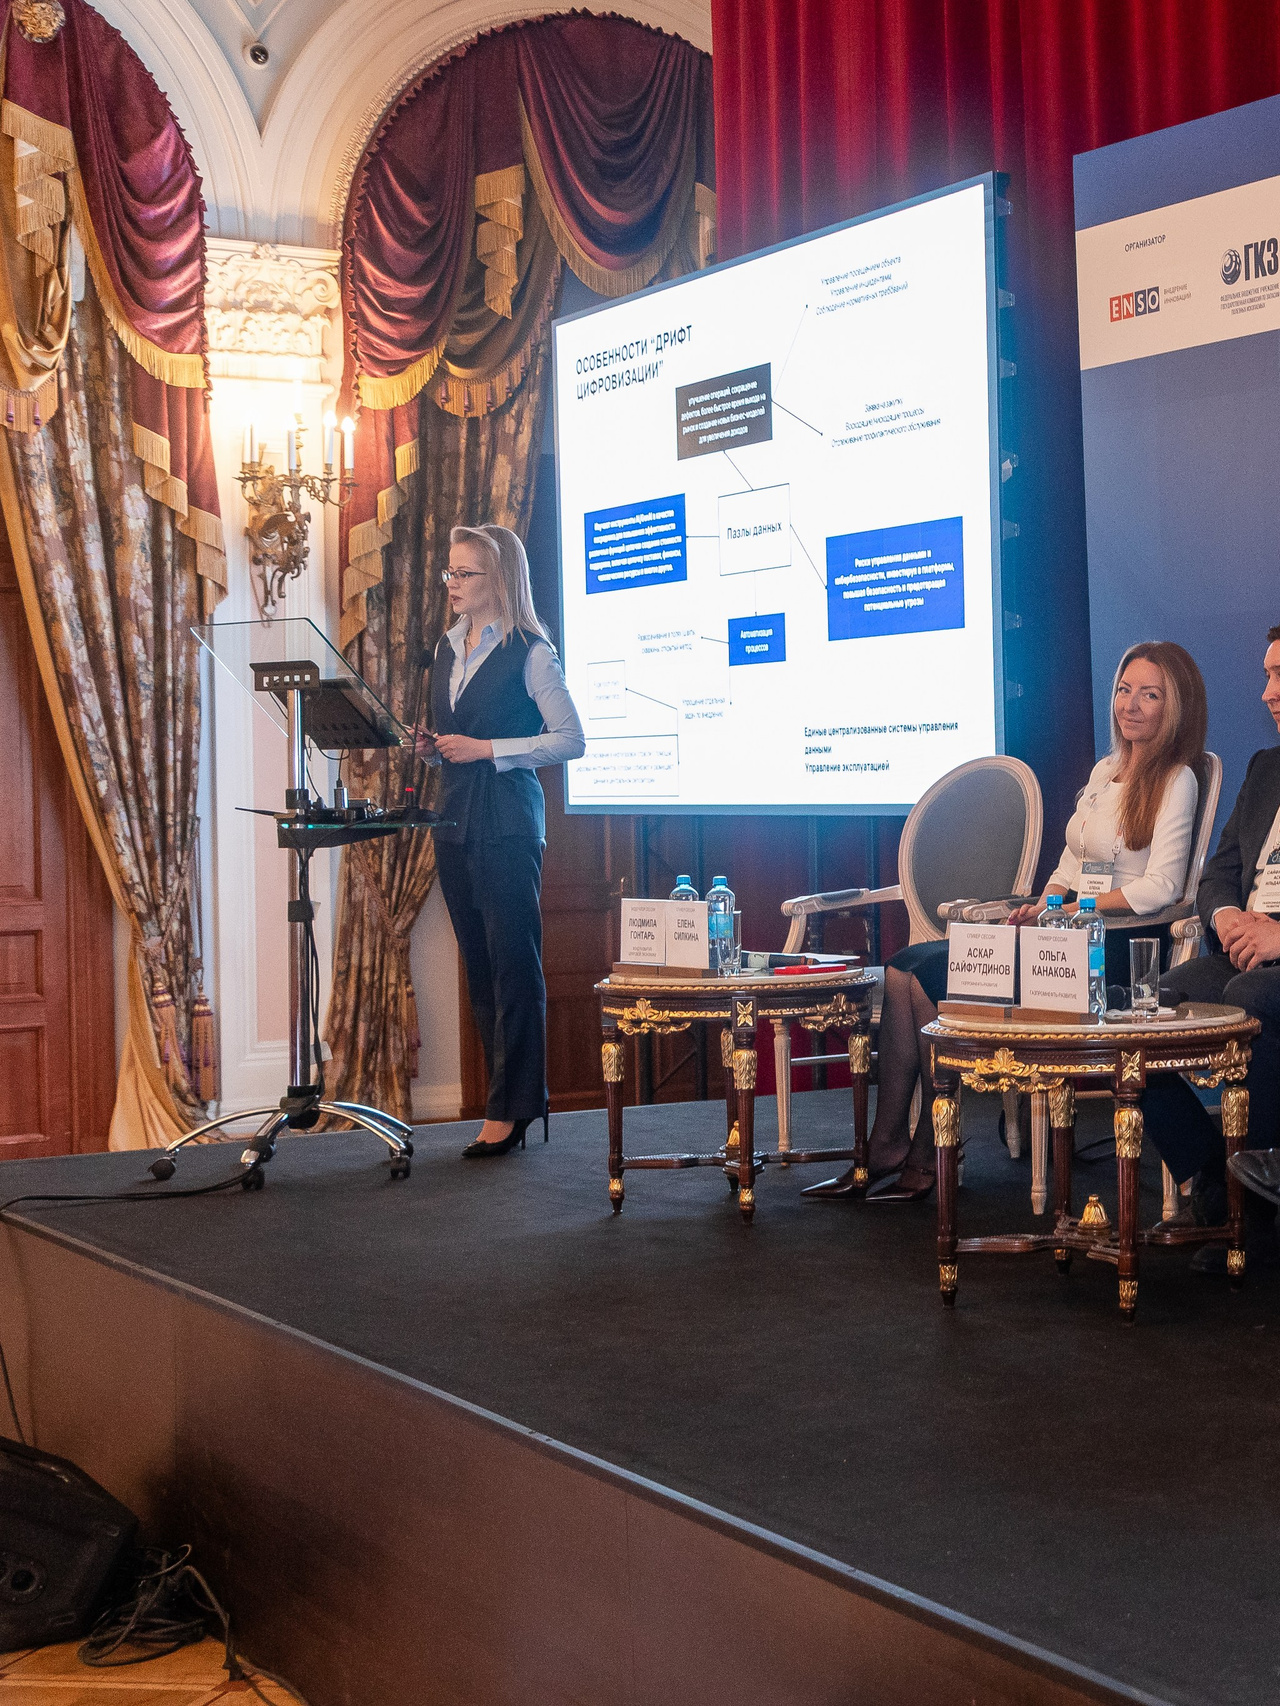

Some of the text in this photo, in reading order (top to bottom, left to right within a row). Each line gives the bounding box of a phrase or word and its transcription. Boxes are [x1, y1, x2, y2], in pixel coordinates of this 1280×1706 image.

[1124, 234, 1166, 252] ОРГАНИЗАТОР
[1244, 238, 1279, 282] ГКЗ
[1164, 284, 1188, 295] ВНЕДРЕНИЕ
[1111, 288, 1159, 320] ENSO
[1164, 292, 1192, 304] ИННОВАЦИЙ
[576, 338, 648, 375] ОСОБЕННОСТИ
[726, 521, 782, 540] Пазлы данных
[804, 722, 958, 738] Единые централизованные системы управления
[805, 746, 832, 755] данными
[805, 760, 890, 774] Управление эксплуатацией
[629, 918, 657, 928] ЛЮДМИЛА
[677, 920, 695, 928] ЕЛЕНА
[630, 932, 655, 940] ГОНТАРЬ
[674, 932, 699, 942] СИЛКИНА
[967, 947, 994, 959] АСКАР
[1039, 950, 1066, 962] ОЛЬГА
[950, 960, 1010, 976] САЙФУТДИНОВ
[1032, 965, 1076, 979] КАНАКОВА
